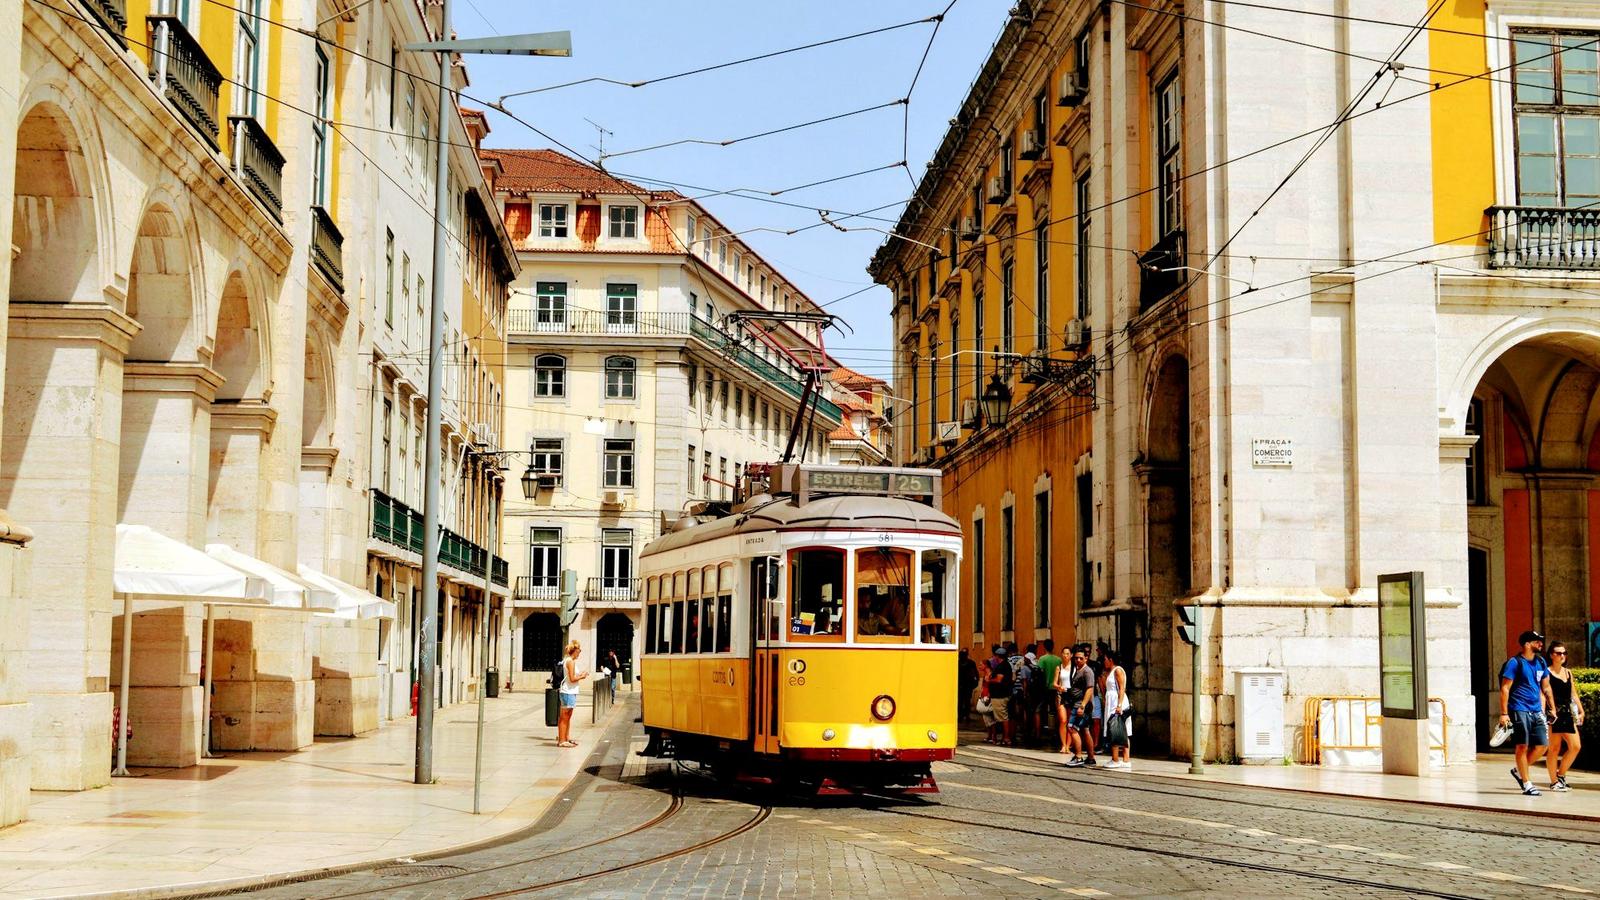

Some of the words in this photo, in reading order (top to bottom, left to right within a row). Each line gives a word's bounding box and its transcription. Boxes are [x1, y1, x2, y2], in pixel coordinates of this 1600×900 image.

[813, 472, 882, 486] ESTRELA
[899, 475, 921, 491] 25
[878, 533, 894, 543] 581
